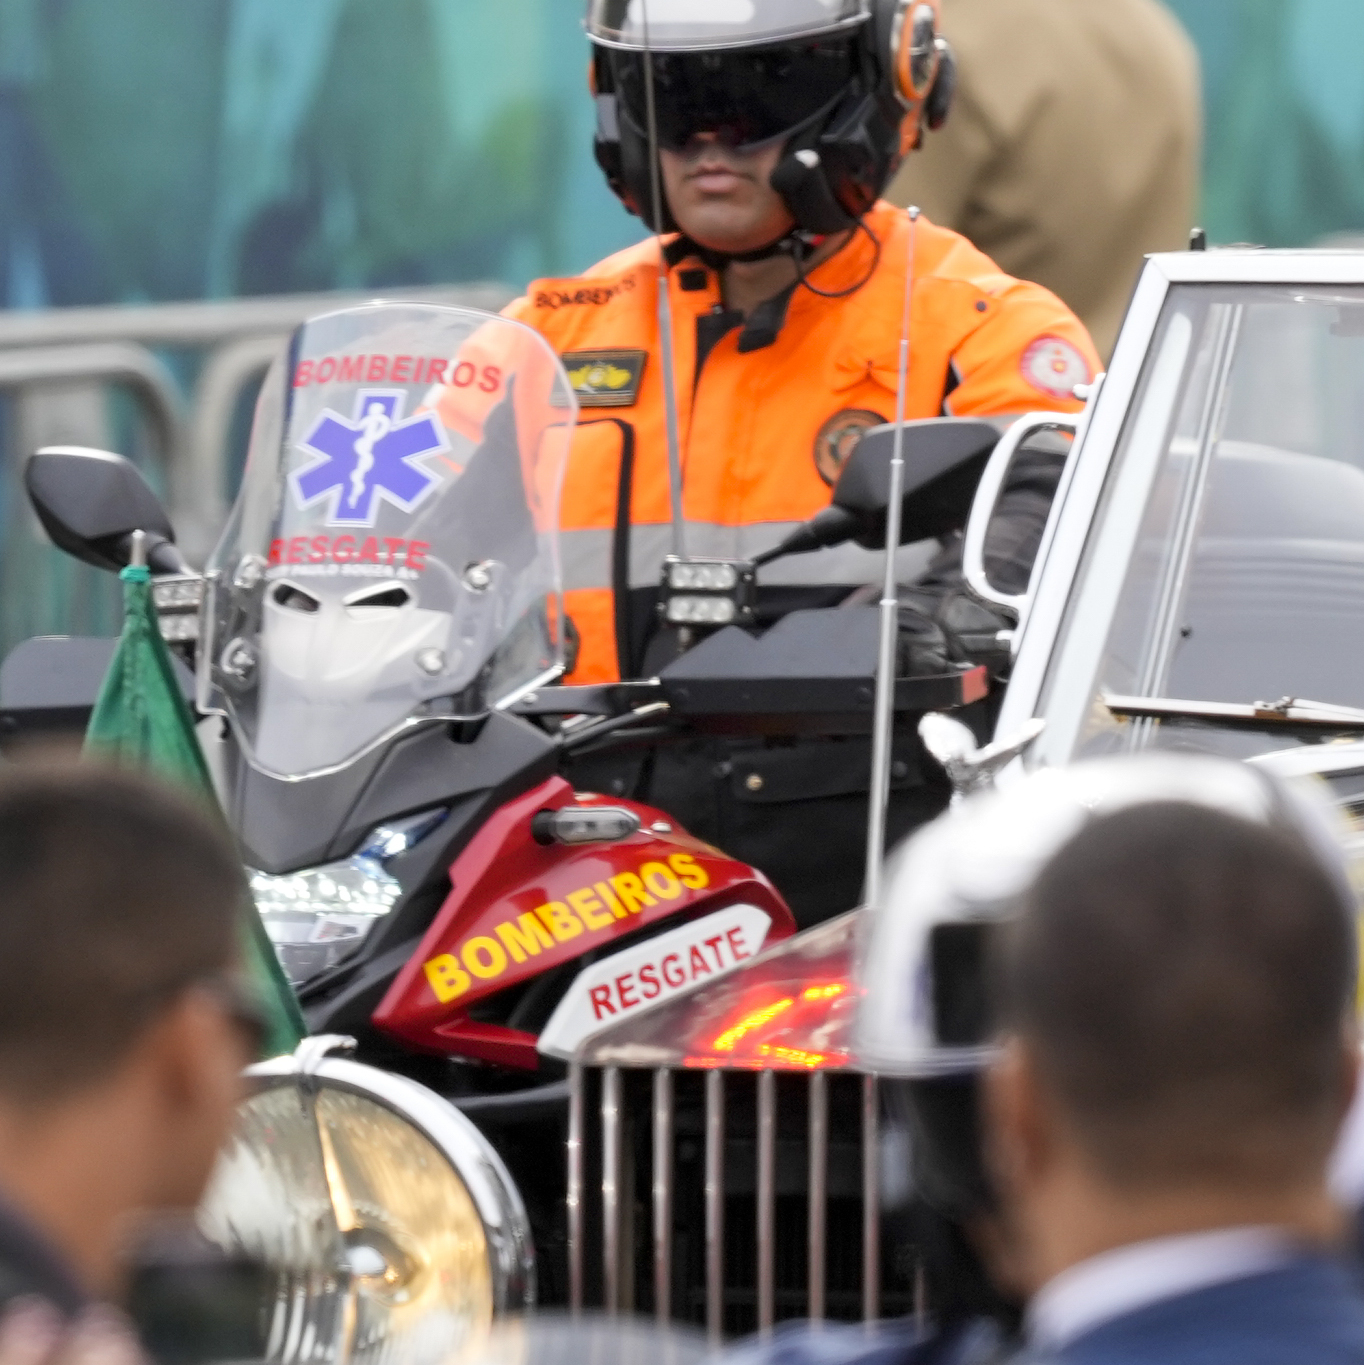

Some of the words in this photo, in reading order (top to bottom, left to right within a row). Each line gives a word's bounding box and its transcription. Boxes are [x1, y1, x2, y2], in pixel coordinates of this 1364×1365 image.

[293, 354, 502, 393] BOMBEIROS
[267, 534, 431, 571] RESGATE
[423, 853, 710, 1004] BOMBEIROS
[588, 926, 750, 1022] RESGATE
